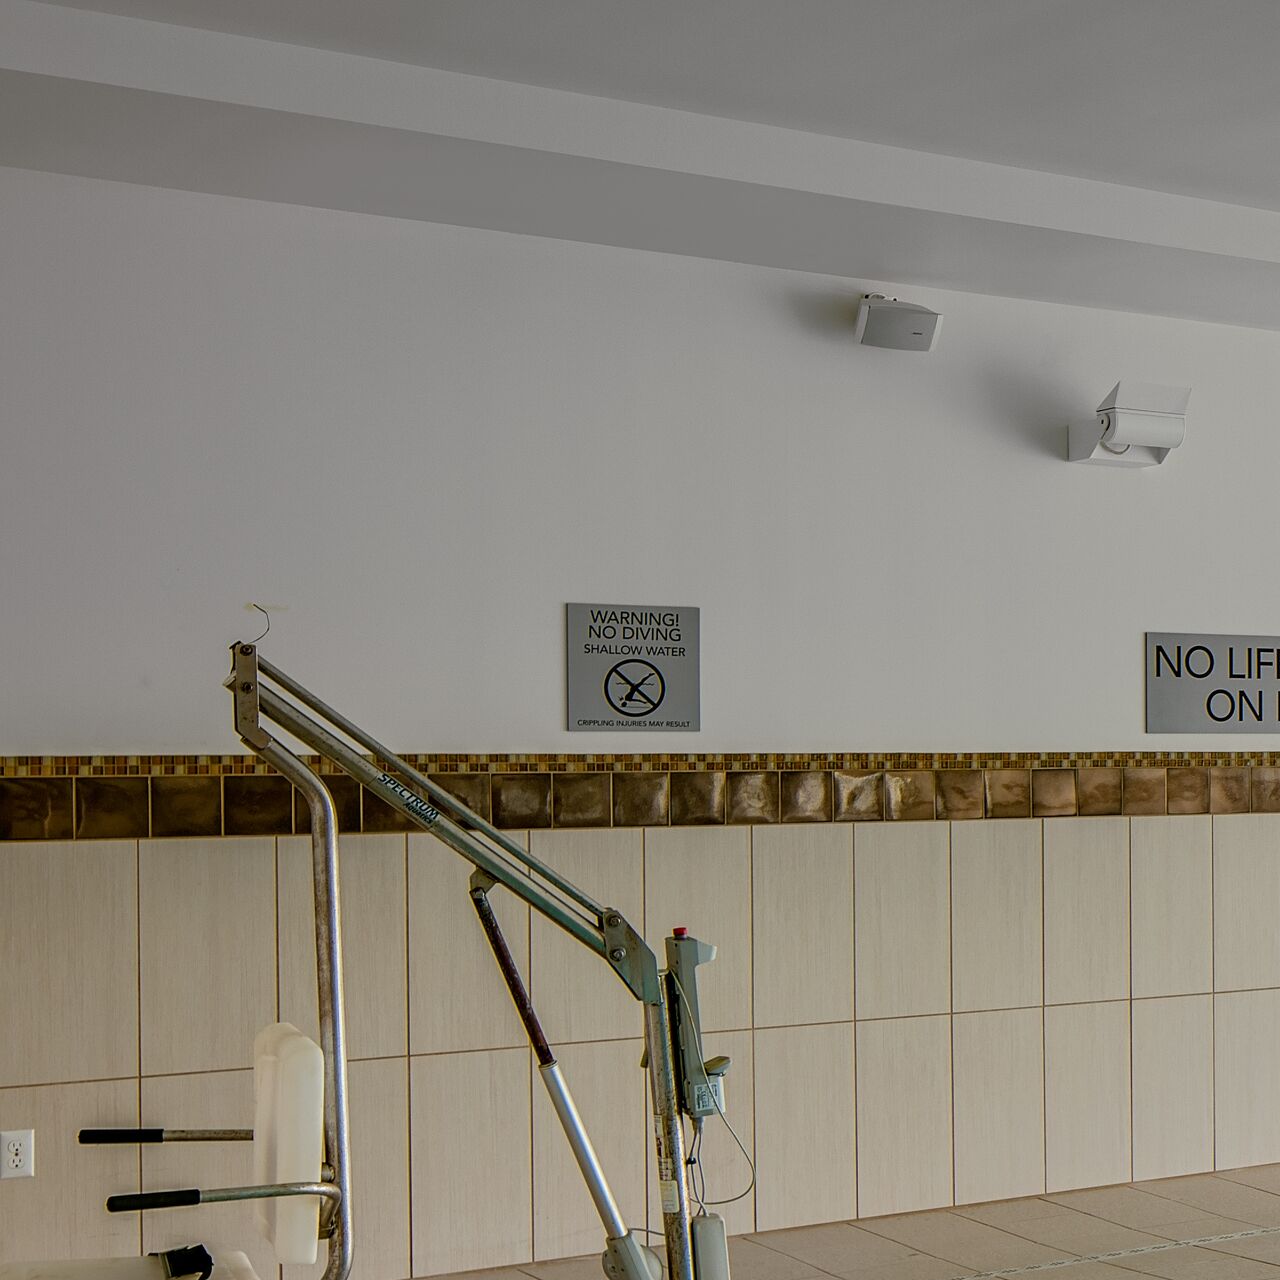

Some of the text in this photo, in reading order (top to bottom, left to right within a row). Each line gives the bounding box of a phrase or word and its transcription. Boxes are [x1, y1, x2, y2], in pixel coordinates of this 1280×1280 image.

[590, 610, 679, 627] WARNING!
[588, 625, 681, 642] NO DIVING
[584, 643, 686, 657] SHALLOW WATER
[1155, 645, 1215, 678] NO
[1206, 689, 1263, 722] ON
[577, 719, 615, 727] CRIPPLING
[666, 720, 690, 728] RESULT
[378, 773, 440, 820] SPECTRUM
